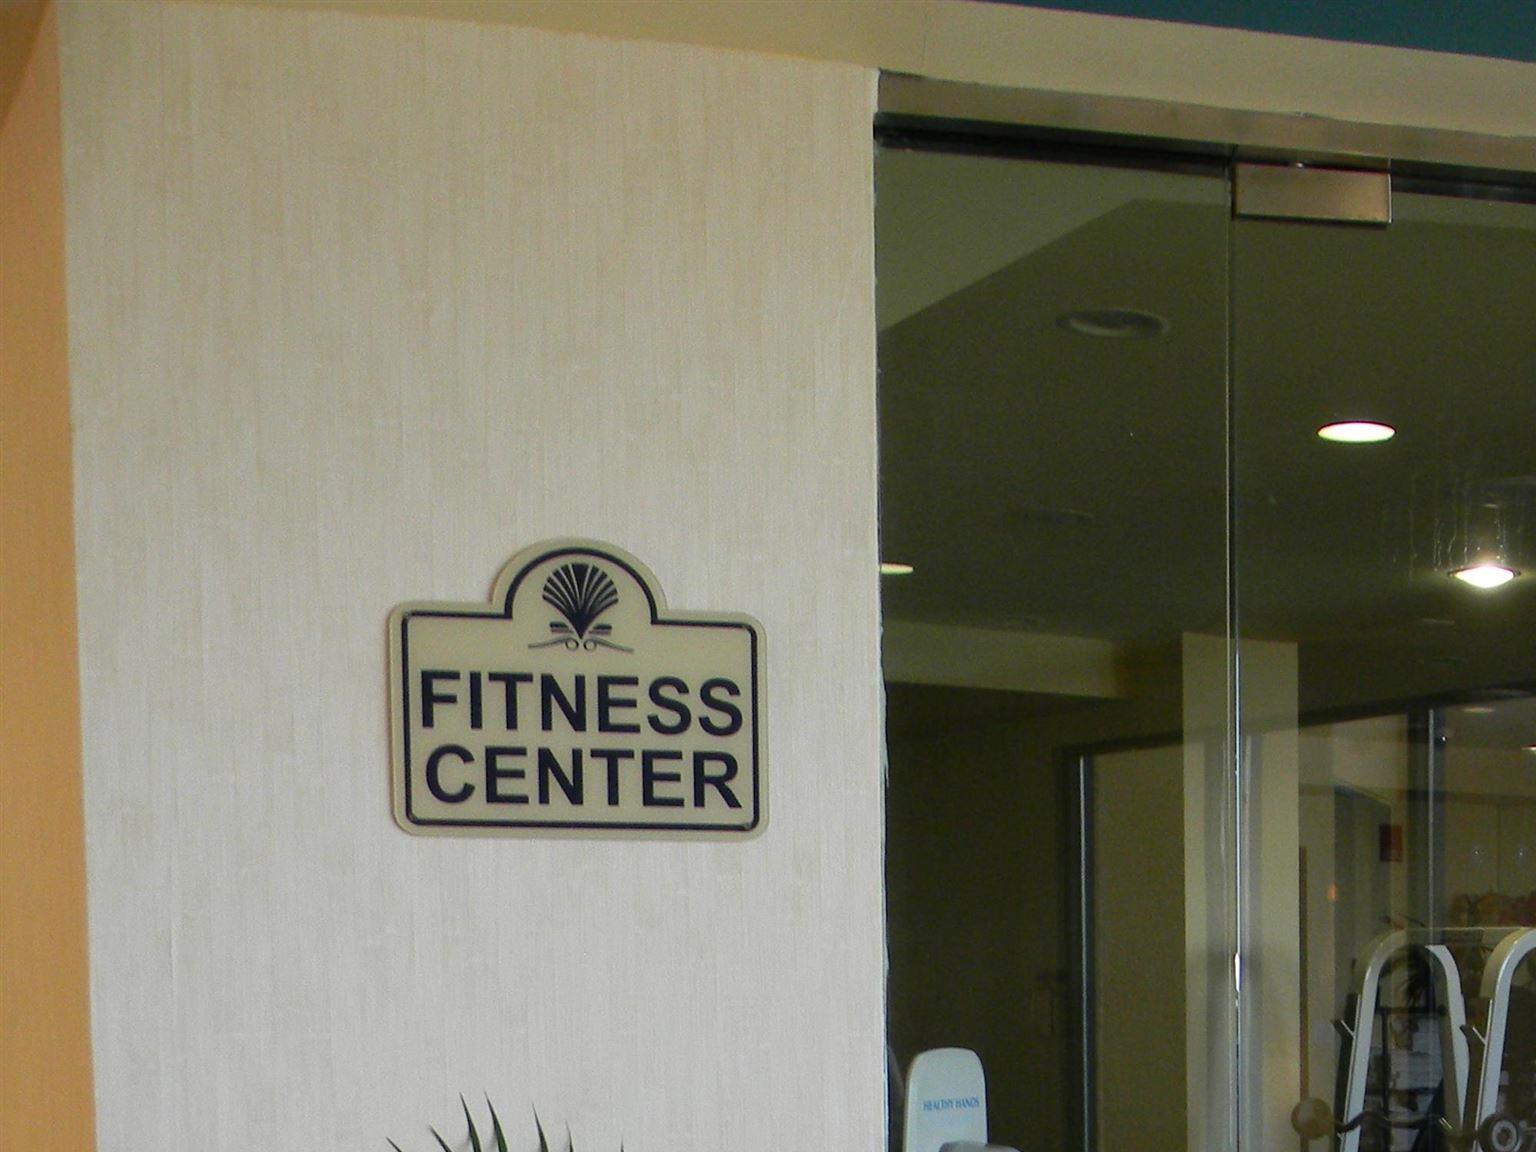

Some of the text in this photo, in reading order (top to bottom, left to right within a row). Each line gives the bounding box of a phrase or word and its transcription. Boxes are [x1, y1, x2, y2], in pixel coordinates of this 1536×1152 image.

[420, 669, 744, 737] FITNESS
[424, 743, 743, 810] CENTER
[922, 1098, 954, 1112] HEALTHY
